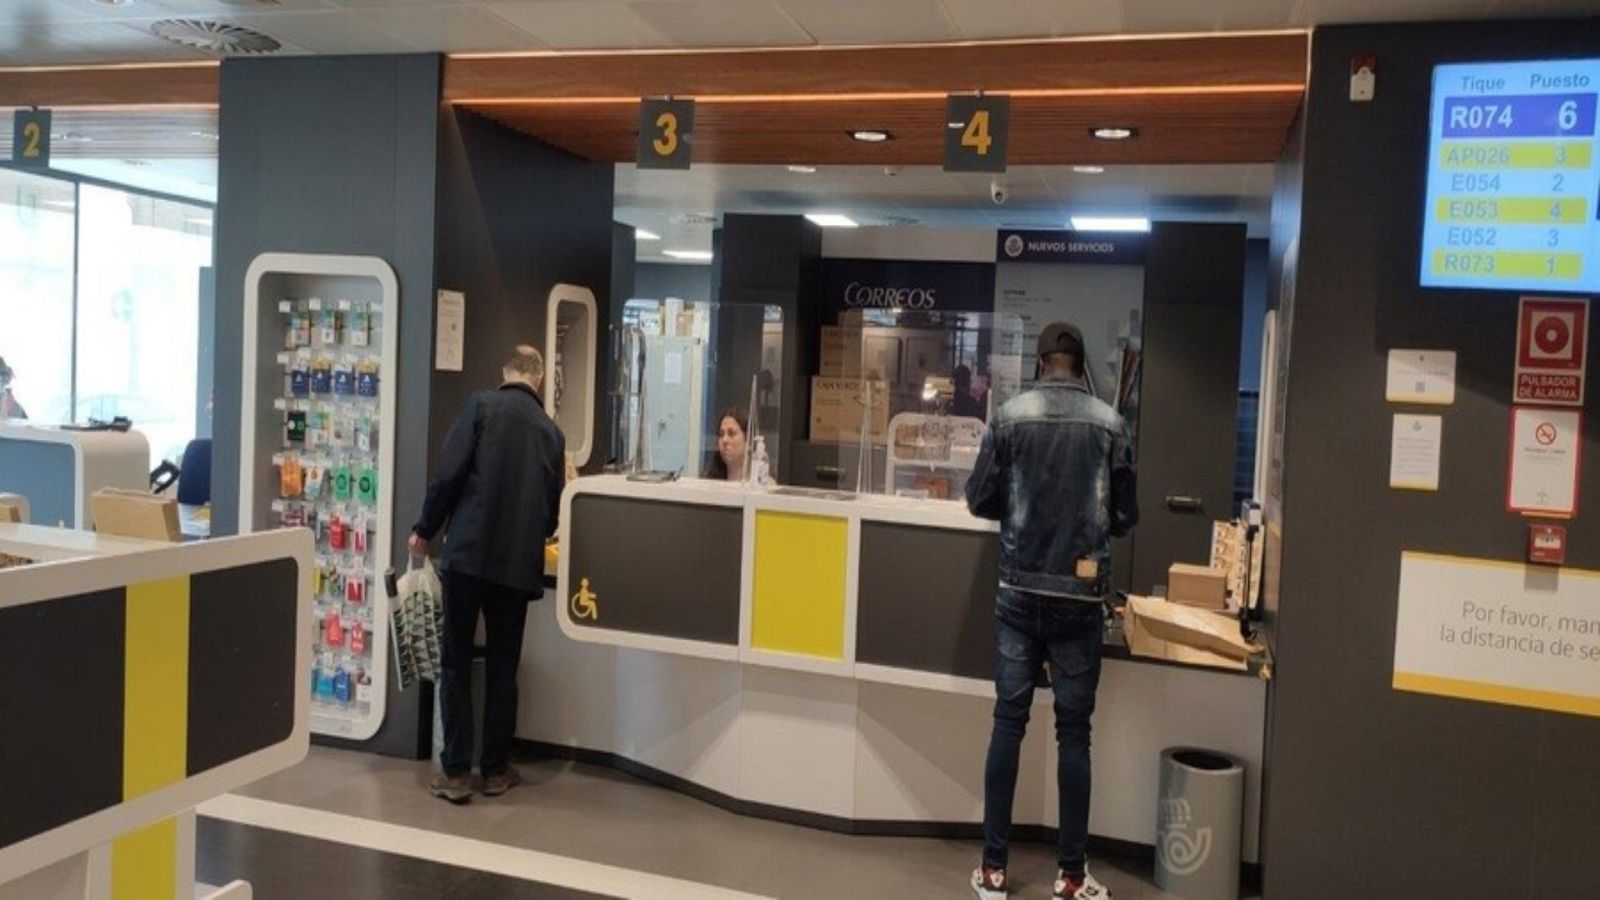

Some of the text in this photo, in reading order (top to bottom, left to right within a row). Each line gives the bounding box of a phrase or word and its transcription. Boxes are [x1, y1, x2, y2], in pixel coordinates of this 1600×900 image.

[1460, 73, 1590, 92] Tique Puesto
[1450, 100, 1578, 129] R074 6
[24, 122, 40, 157] 2
[653, 112, 678, 156] 3
[961, 110, 992, 155] 4
[1446, 146, 1566, 164] AP026 3
[1451, 173, 1565, 192] E054 2
[1449, 201, 1561, 219] E053 4
[1447, 227, 1559, 247] E052 3
[1028, 242, 1114, 253] NUEVOS SERVICIOS
[1444, 254, 1555, 274] R073 1
[1521, 375, 1577, 387] PULSADOR
[1519, 387, 1577, 399] DE ALARMA
[1462, 600, 1495, 622] Por
[1500, 605, 1552, 631] favor,
[1440, 624, 1456, 643] la
[1460, 626, 1545, 654] distancia
[1550, 638, 1574, 658] de
